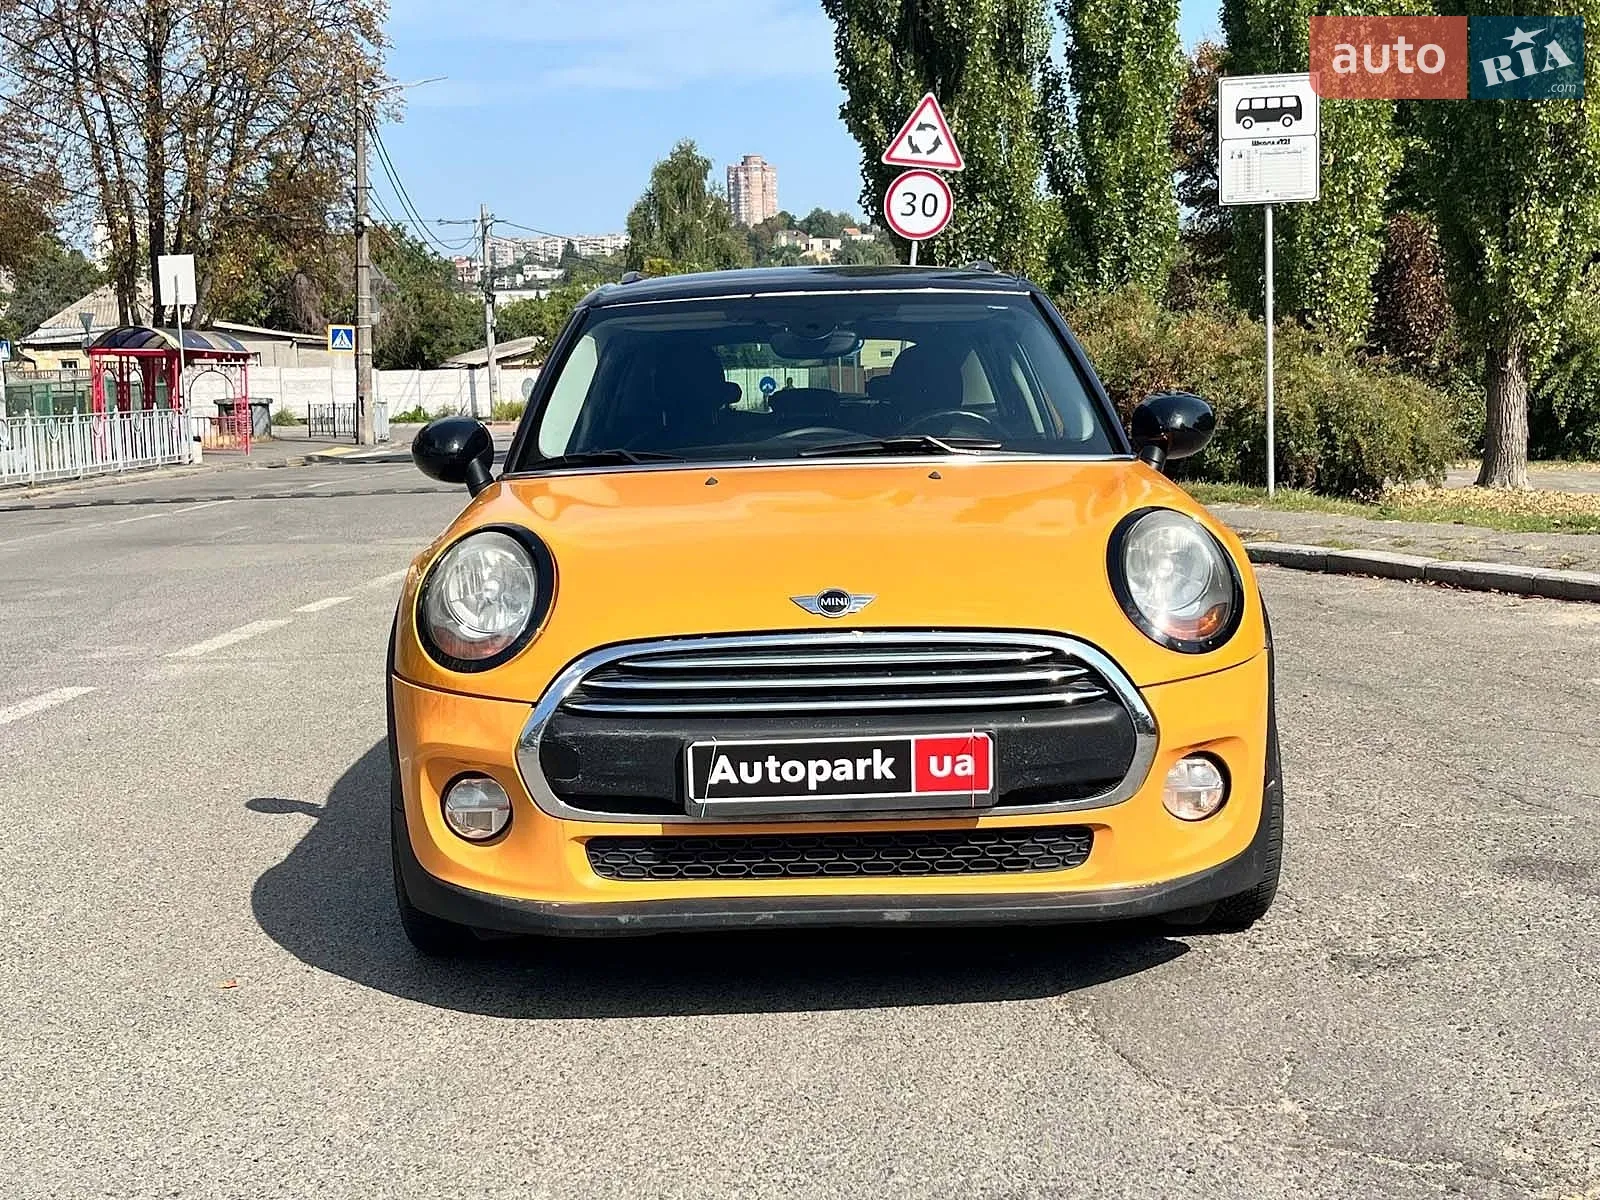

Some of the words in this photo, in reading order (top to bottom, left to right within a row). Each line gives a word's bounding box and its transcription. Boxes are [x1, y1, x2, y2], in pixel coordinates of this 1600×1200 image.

[900, 192, 938, 217] 30
[820, 596, 849, 608] MINI
[708, 748, 896, 790] Autopark
[928, 753, 975, 779] ua
